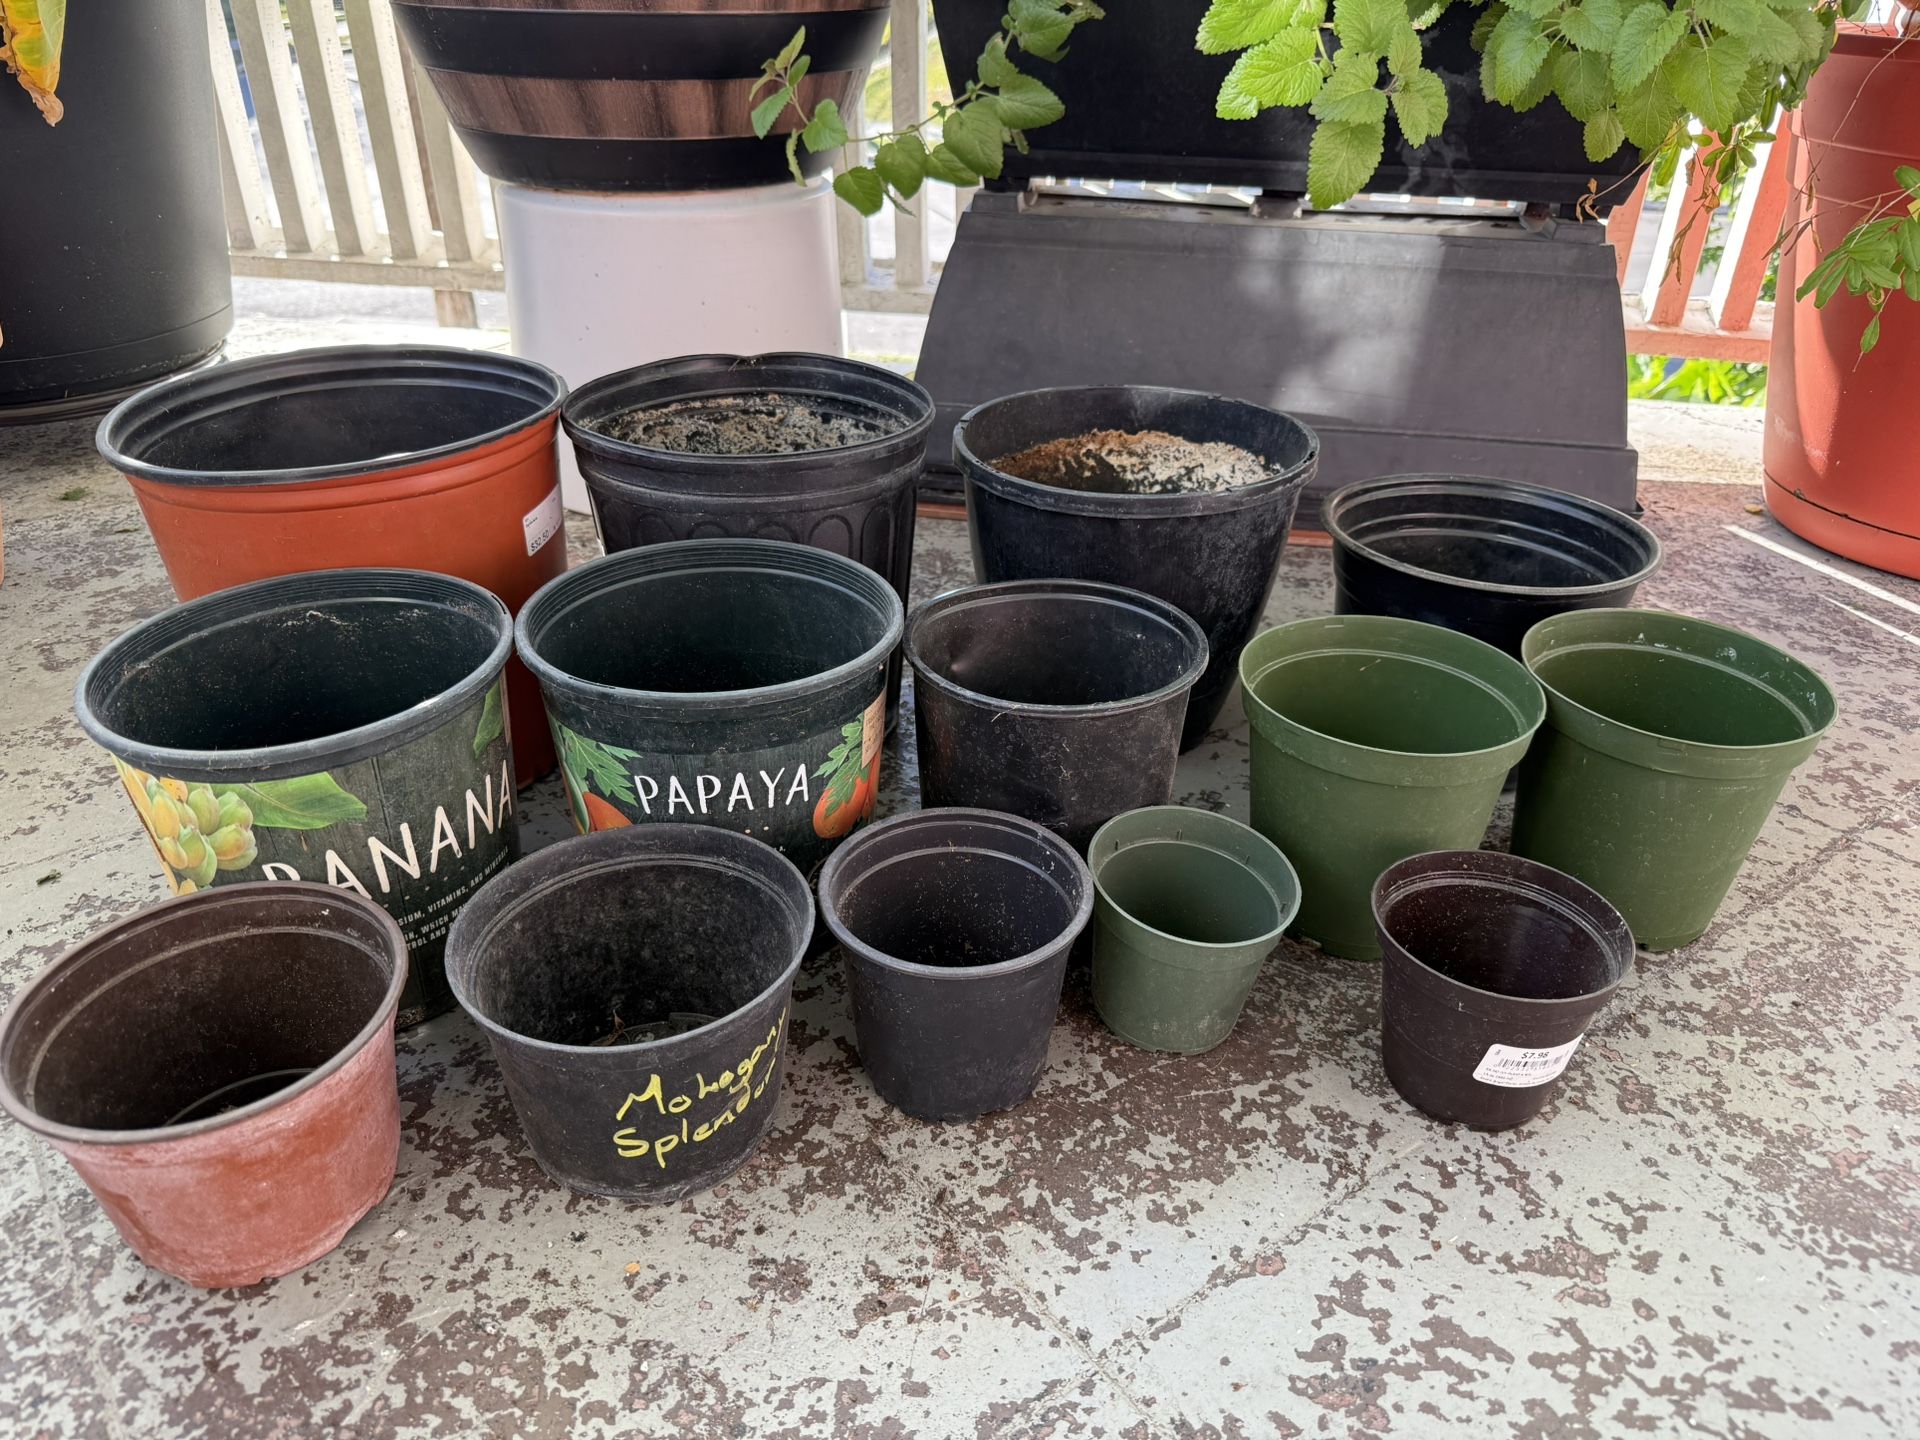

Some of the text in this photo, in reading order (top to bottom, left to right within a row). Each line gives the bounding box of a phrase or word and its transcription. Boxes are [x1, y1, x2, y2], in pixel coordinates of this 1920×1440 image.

[634, 763, 810, 815] PAPAYA
[427, 886, 469, 913] VITAMINS,
[470, 872, 484, 888] AND
[420, 914, 449, 934] WHICH
[430, 927, 447, 941] AND
[1521, 1051, 1550, 1060] $7.98
